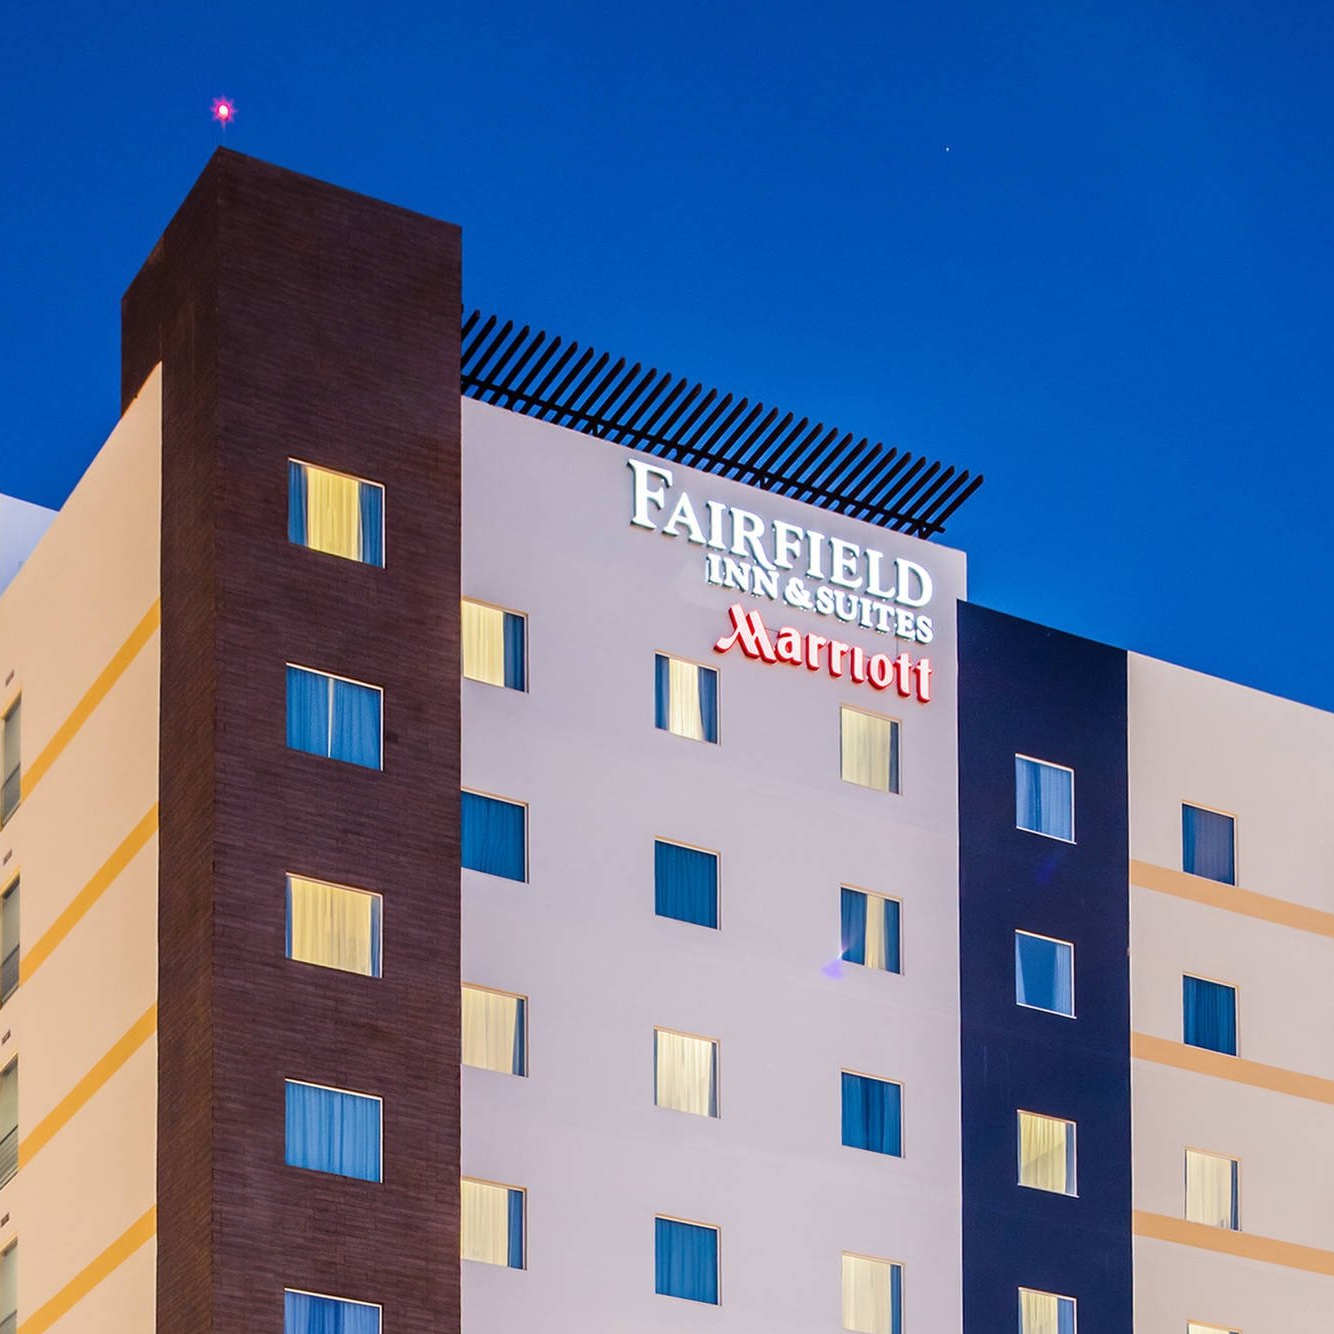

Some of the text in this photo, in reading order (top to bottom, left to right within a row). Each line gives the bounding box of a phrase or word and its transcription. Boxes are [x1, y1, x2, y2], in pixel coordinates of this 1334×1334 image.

[627, 457, 934, 609] FAIRFIELD
[705, 553, 934, 644] INN & SUITES
[713, 603, 932, 703] Marriott
